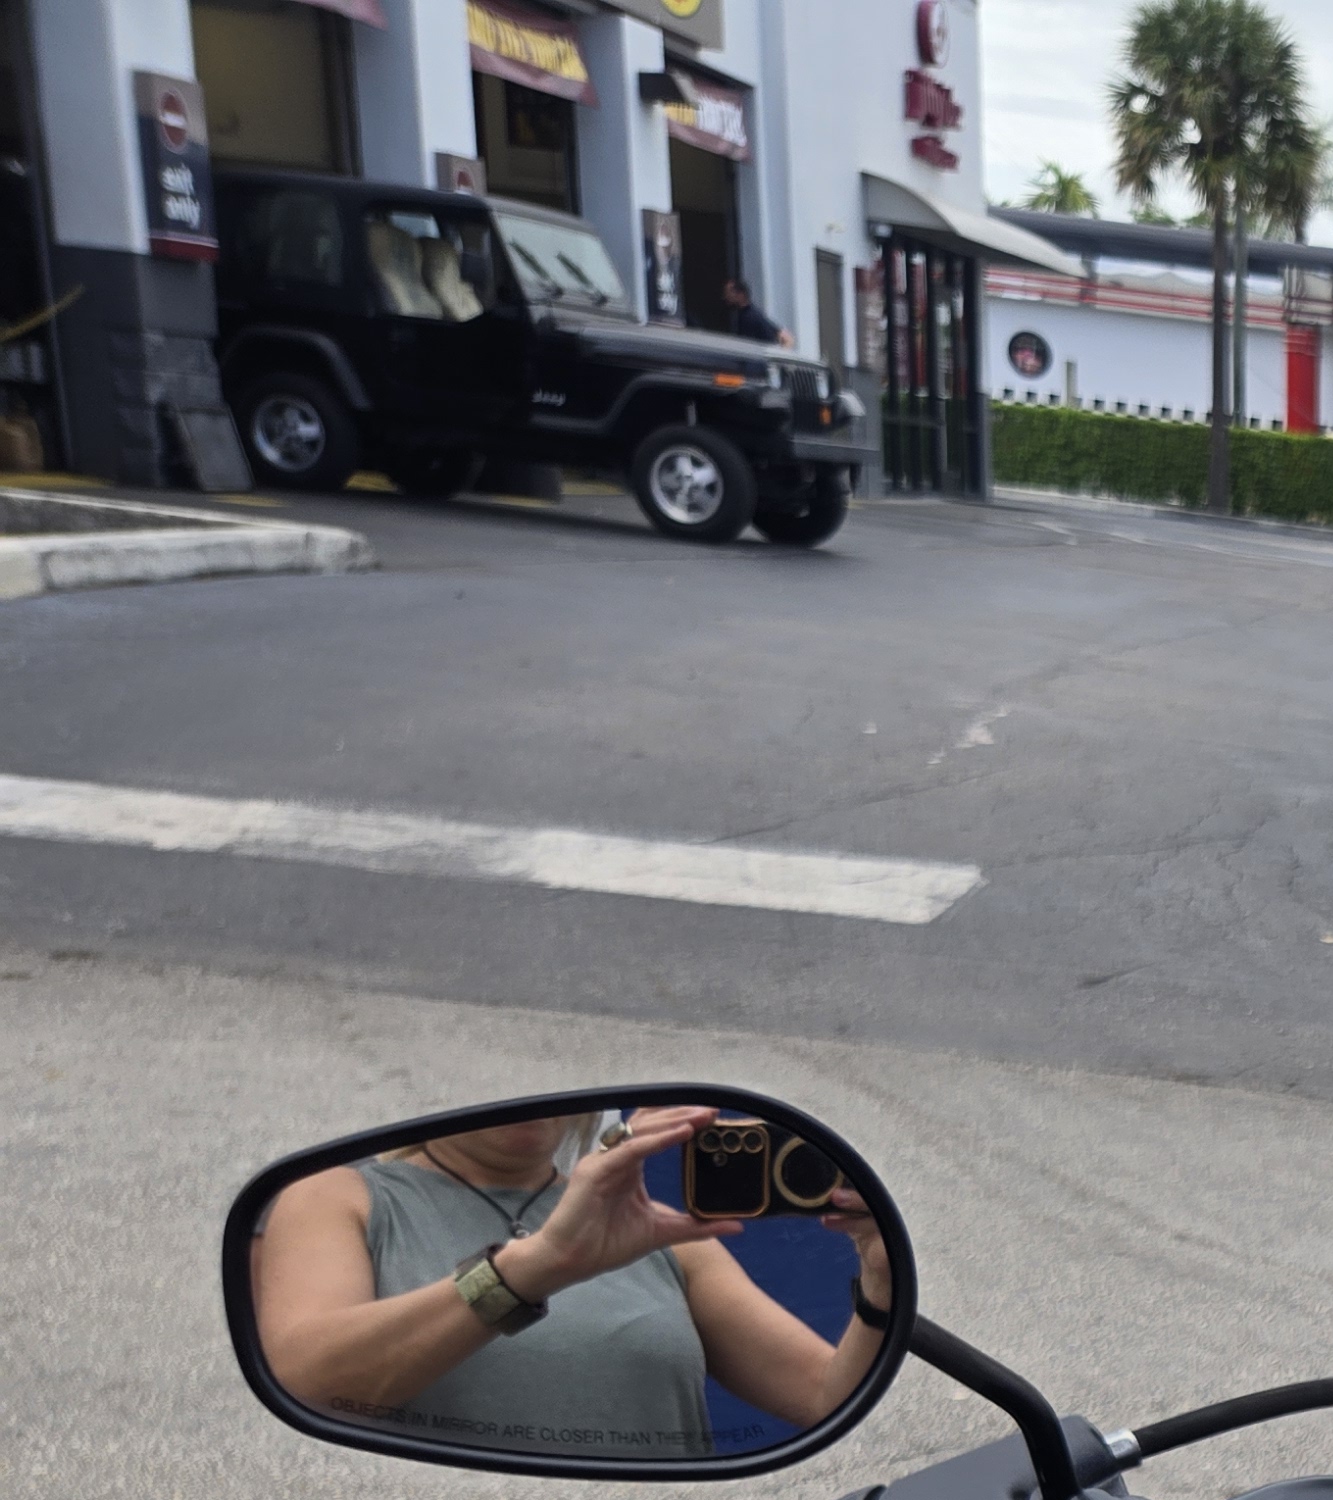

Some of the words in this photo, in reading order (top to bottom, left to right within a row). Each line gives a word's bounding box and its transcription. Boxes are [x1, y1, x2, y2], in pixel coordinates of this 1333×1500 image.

[331, 1396, 407, 1424] OBJECTS
[410, 1412, 429, 1427] IN
[432, 1415, 498, 1436] MIRROR
[503, 1425, 535, 1440] ARE
[539, 1427, 604, 1444] CLOSER
[610, 1431, 651, 1445] THAN
